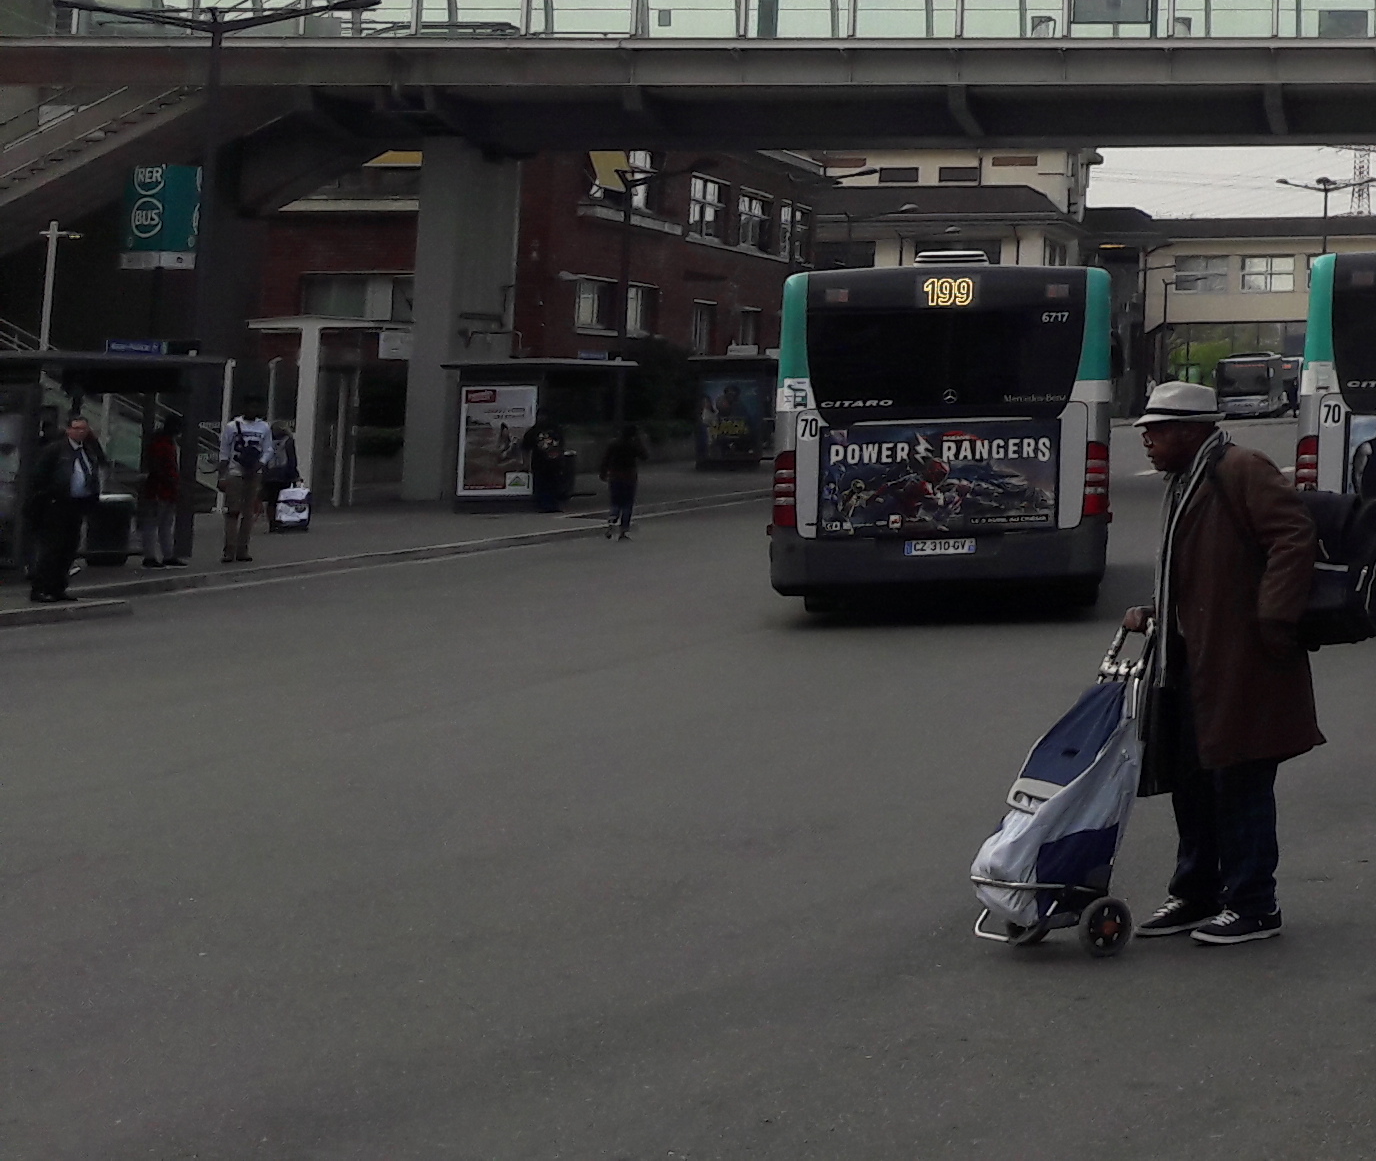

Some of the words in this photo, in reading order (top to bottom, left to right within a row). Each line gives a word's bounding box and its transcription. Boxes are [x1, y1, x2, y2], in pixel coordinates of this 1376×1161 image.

[137, 167, 163, 182] RER
[134, 209, 160, 225] BUS
[923, 277, 974, 306] 199
[1041, 311, 1070, 323] 6717
[821, 398, 894, 409] CITARO
[1323, 404, 1342, 424] 70
[801, 418, 818, 437] 70
[829, 442, 911, 465] POWER
[942, 437, 1051, 463] RANGERS
